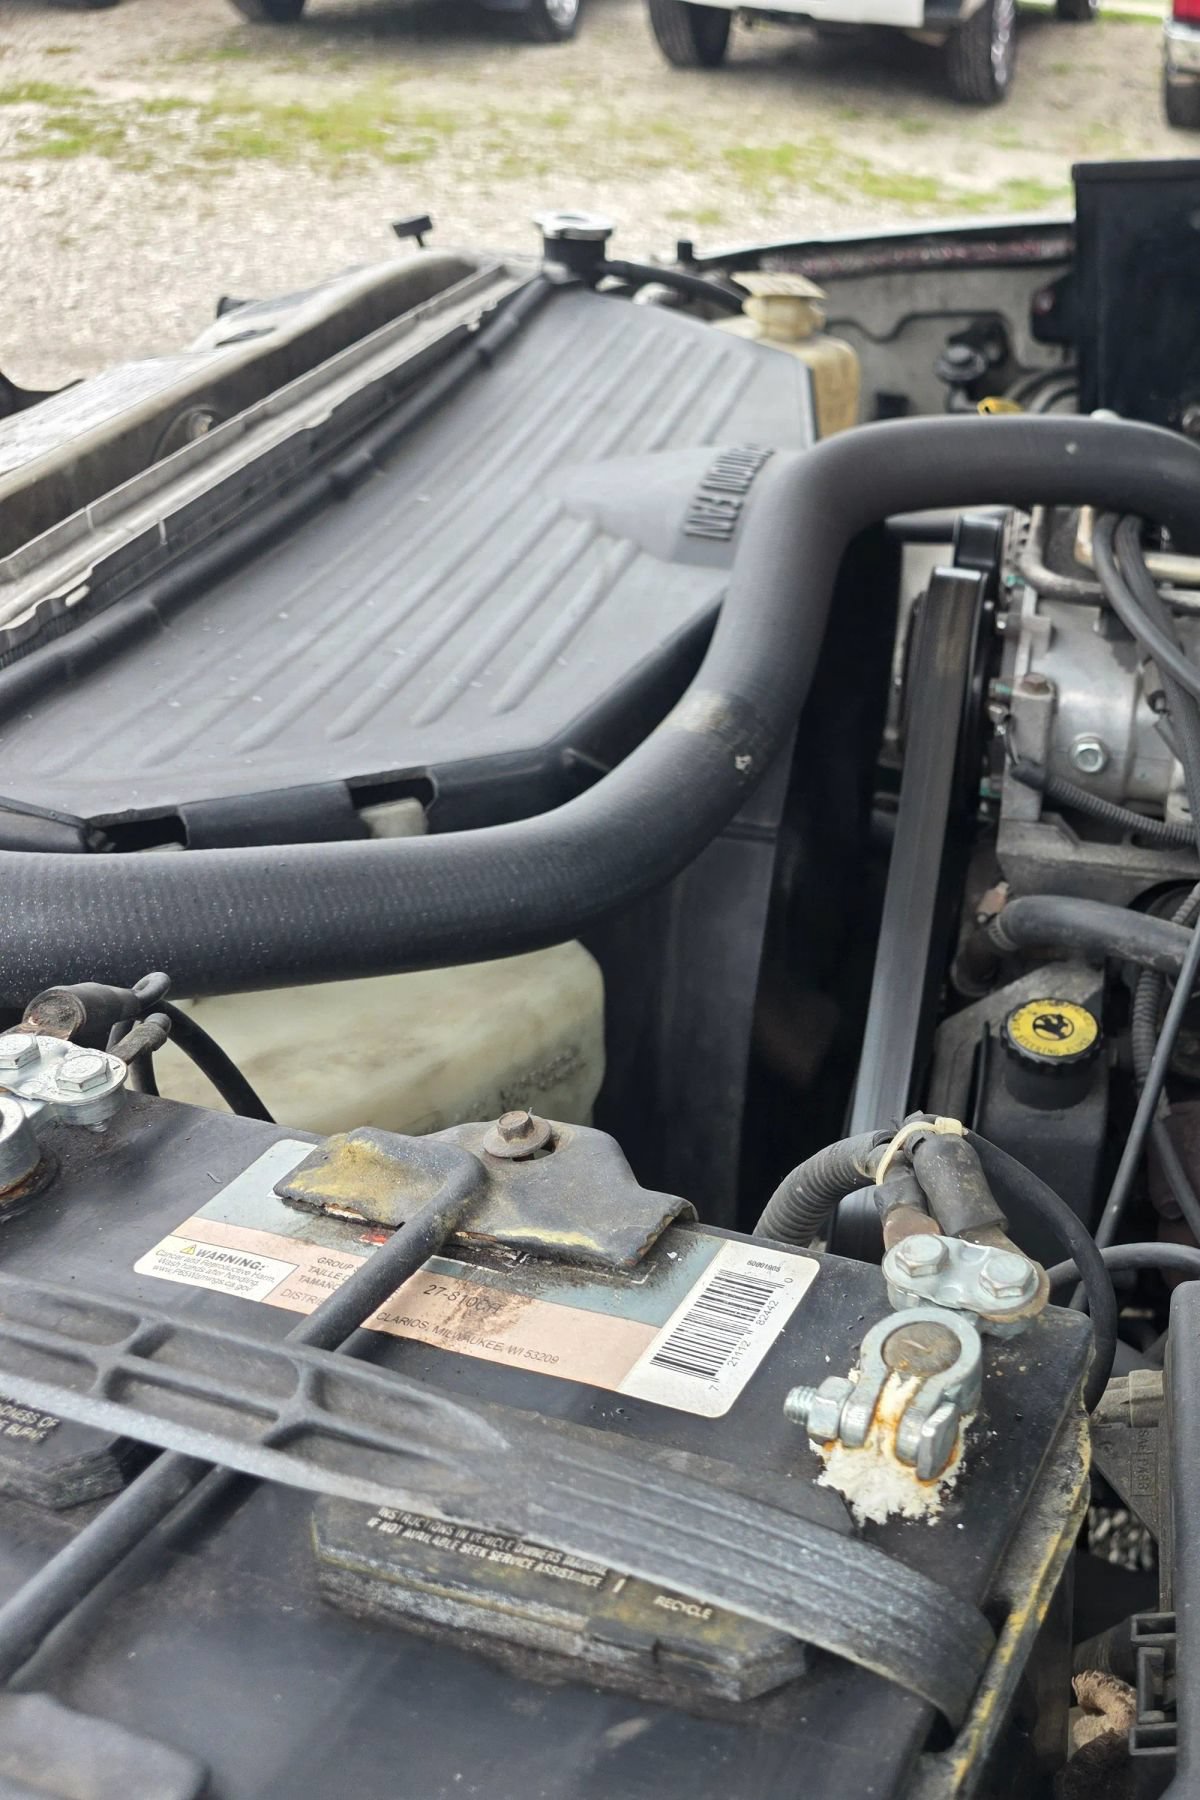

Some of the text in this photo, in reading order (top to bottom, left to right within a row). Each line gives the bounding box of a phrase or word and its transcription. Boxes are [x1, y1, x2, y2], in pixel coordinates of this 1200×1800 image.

[683, 495, 744, 542] FAN
[158, 1257, 180, 1269] Wash
[181, 1261, 206, 1274] hands
[206, 1266, 225, 1277] after
[184, 1254, 201, 1265] and
[195, 1248, 266, 1272] WARNING:
[316, 1256, 354, 1271] GROUP
[307, 1265, 342, 1281] TAILLE
[708, 1276, 794, 1392] 7 21112 82442 0
[507, 1344, 523, 1357] WI
[523, 1348, 560, 1365] 53209
[378, 1506, 453, 1536] INSTRUCTIONS
[468, 1530, 514, 1551] VEHICLE
[514, 1541, 563, 1564] OWNERS
[367, 1517, 604, 1588] IF NOT AVAILABLE SEEK SERVICE ASSISTANCE
[653, 1594, 713, 1620] RECYCLE
